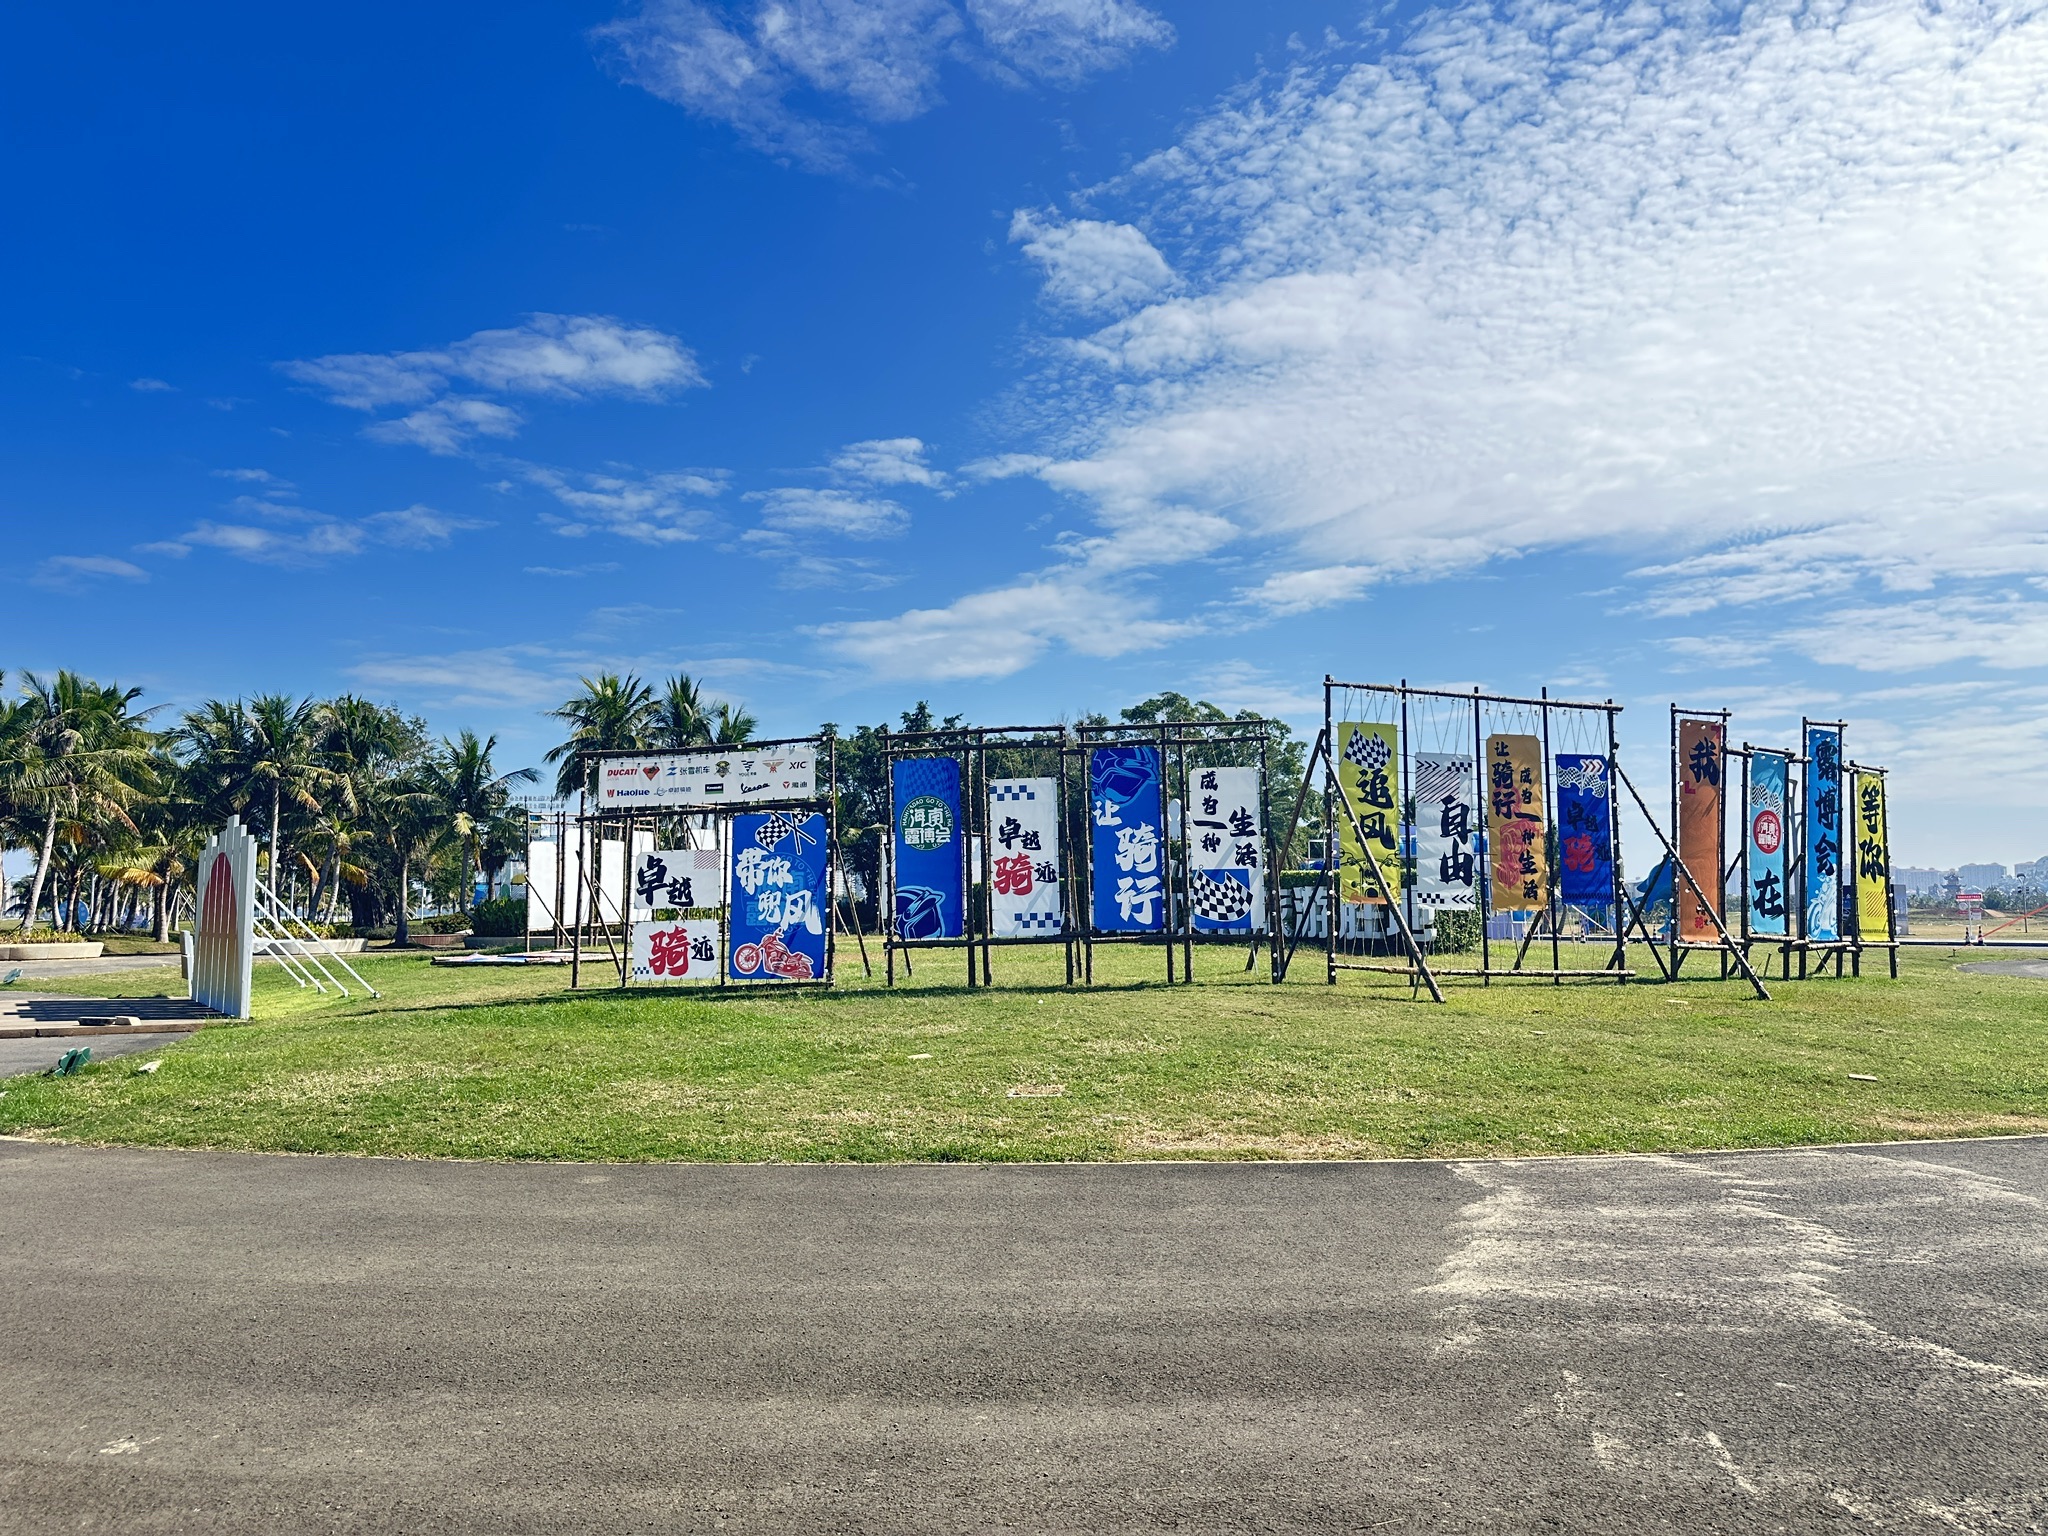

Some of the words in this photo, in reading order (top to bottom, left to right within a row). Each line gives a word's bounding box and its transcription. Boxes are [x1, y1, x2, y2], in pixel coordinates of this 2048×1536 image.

[607, 769, 638, 777] DUCATI
[1492, 741, 1516, 820] 让骑行
[1689, 736, 1719, 786] 我
[909, 807, 944, 828] 海南
[998, 816, 1041, 850] 卓越
[1355, 767, 1396, 850] 追风
[1859, 785, 1885, 884] 等你
[1229, 806, 1258, 868] 生活
[1439, 794, 1474, 887] 自由
[636, 855, 694, 907] 卓越
[735, 847, 793, 895] 带你
[993, 852, 1058, 896] 骑迹
[1752, 867, 1784, 920] 在
[758, 890, 823, 935] 兜风
[648, 924, 715, 977] 骑迹
